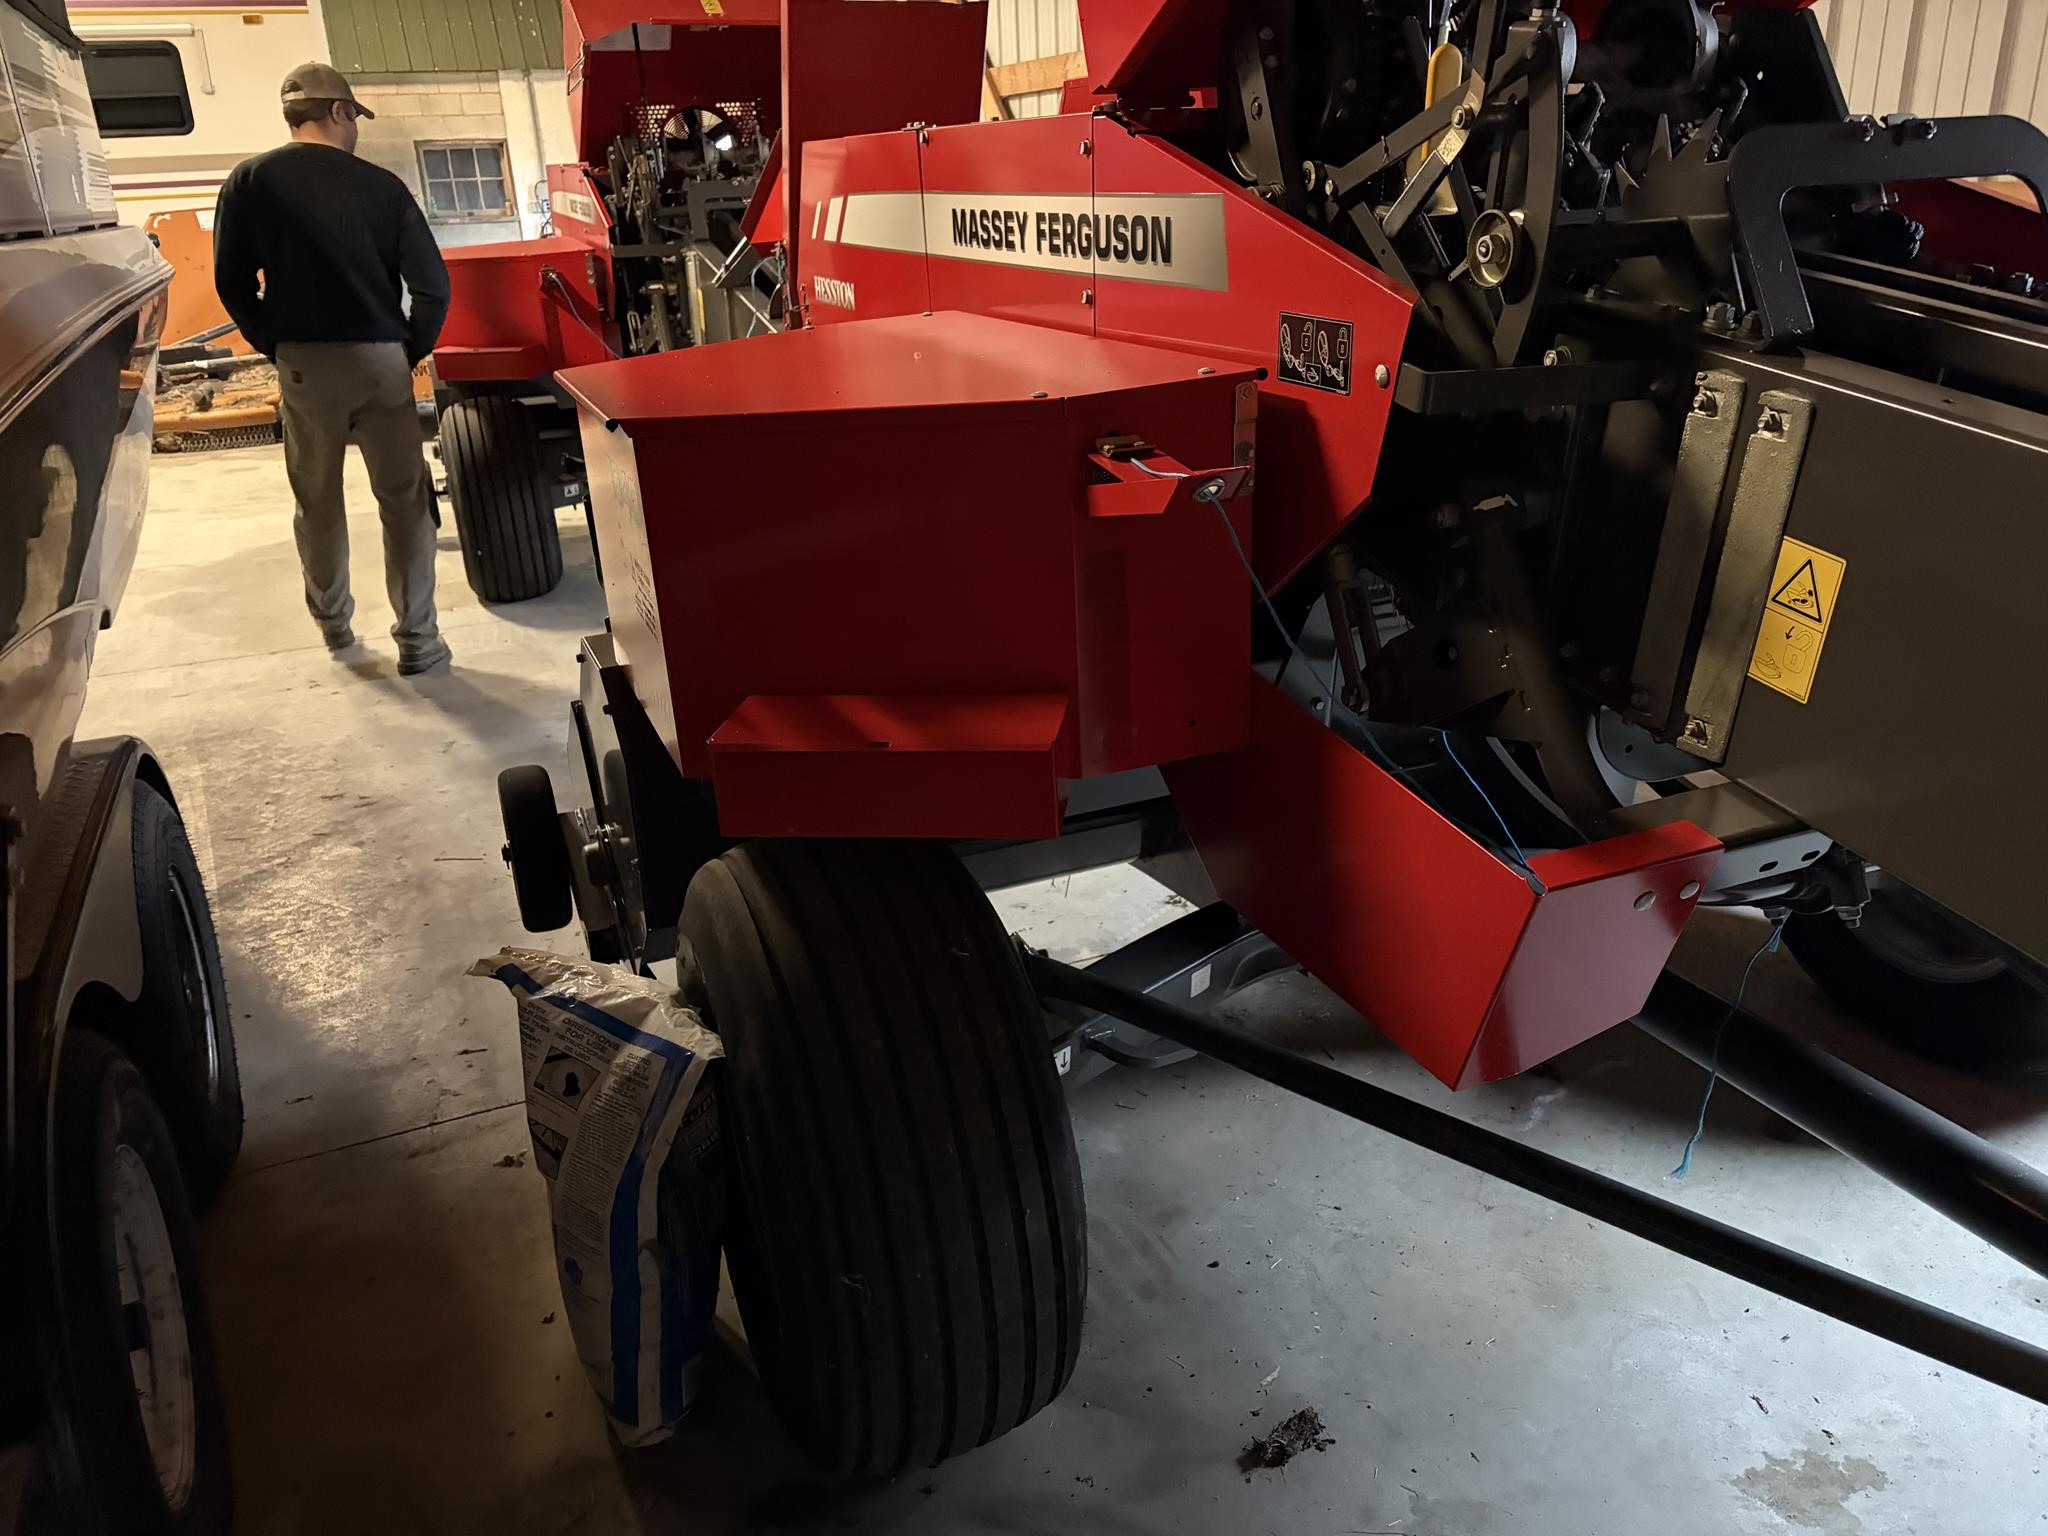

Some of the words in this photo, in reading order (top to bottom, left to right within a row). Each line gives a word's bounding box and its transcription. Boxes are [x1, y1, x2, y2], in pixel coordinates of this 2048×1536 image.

[952, 208, 1028, 253] MASSEY
[1035, 211, 1173, 266] FERGUSON
[813, 275, 855, 311] HESSTON
[562, 1017, 621, 1051] DIRECTIONS
[564, 1027, 584, 1044] FOR
[586, 1037, 609, 1054] USE
